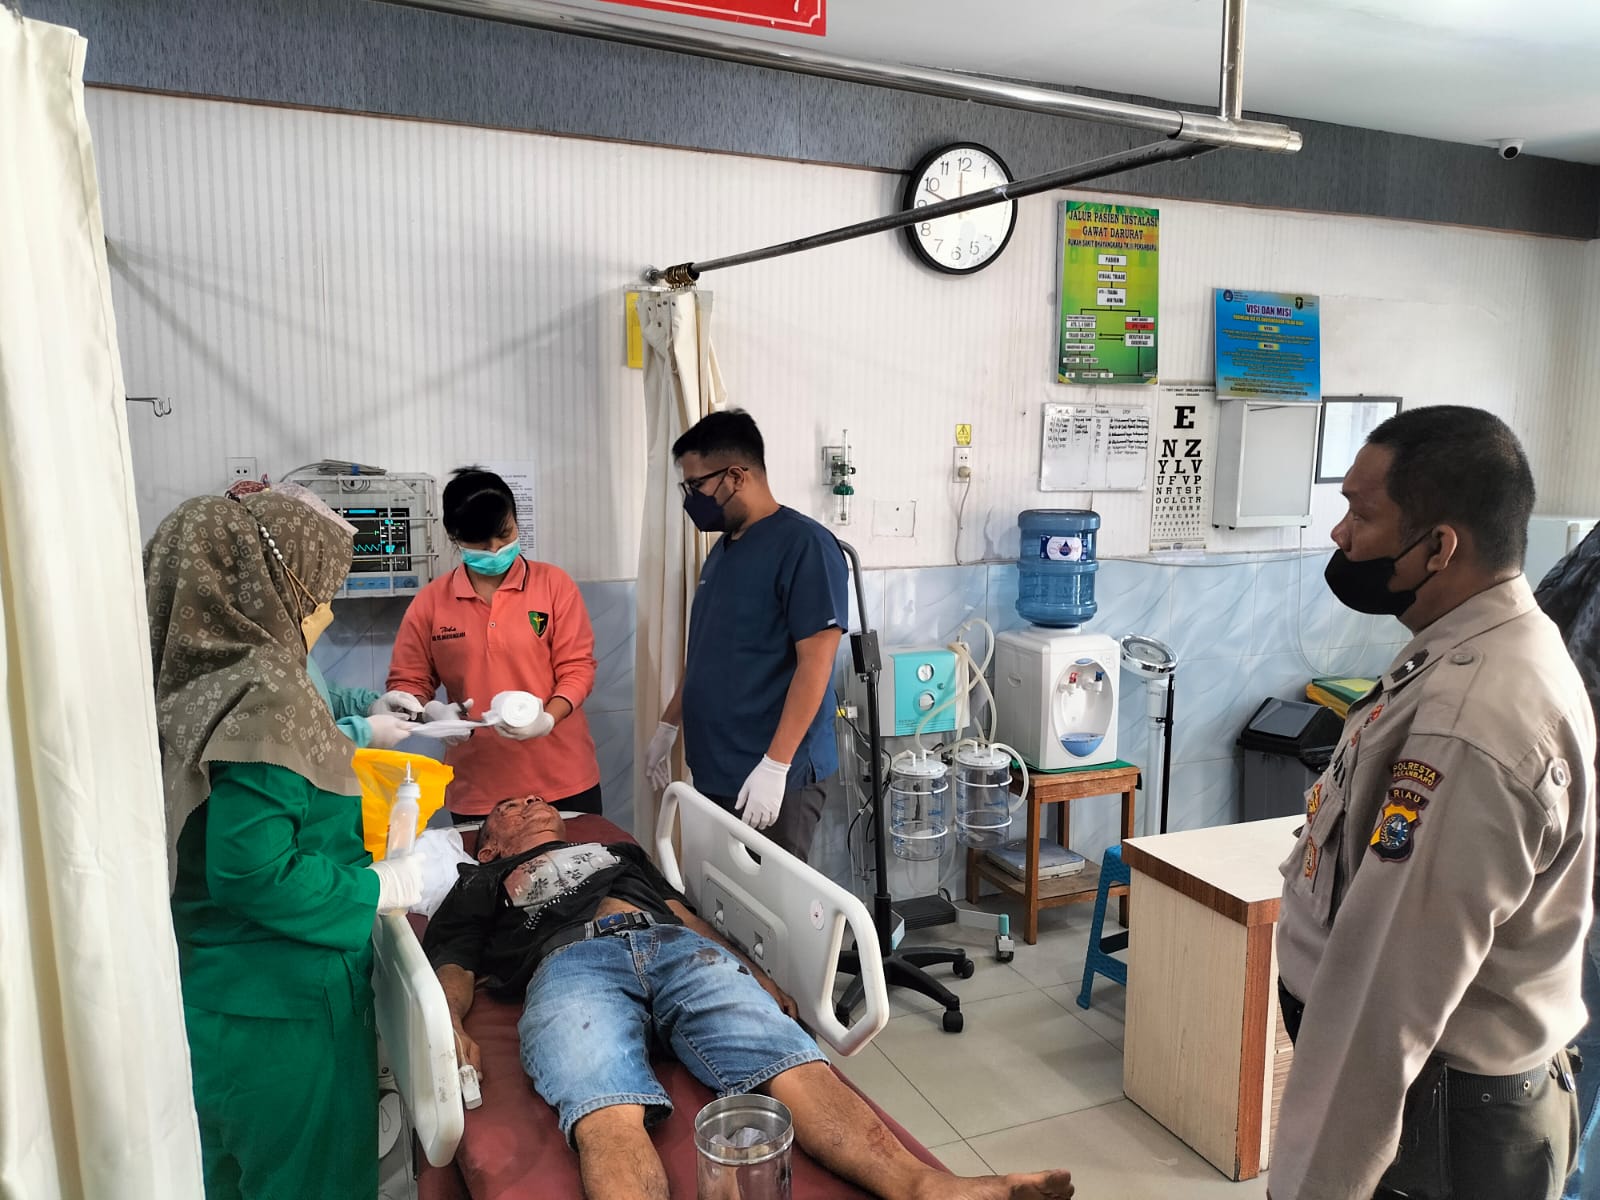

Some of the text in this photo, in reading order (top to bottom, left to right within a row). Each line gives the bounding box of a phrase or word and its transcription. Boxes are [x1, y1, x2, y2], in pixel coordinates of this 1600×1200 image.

[940, 160, 950, 176] 11
[958, 157, 973, 173] 12
[982, 165, 988, 179] 1
[924, 176, 940, 193] 10
[1069, 210, 1158, 227] JALUR PASIEN INSTALASI
[920, 222, 931, 237] 8
[1082, 226, 1143, 240] GAWAT DARURAT
[934, 238, 944, 253] 7
[969, 241, 980, 256] 5
[951, 246, 961, 261] 6
[1246, 304, 1292, 317] VISI DAN MISI
[1173, 406, 1196, 429] E
[1393, 789, 1421, 803] RIAU
